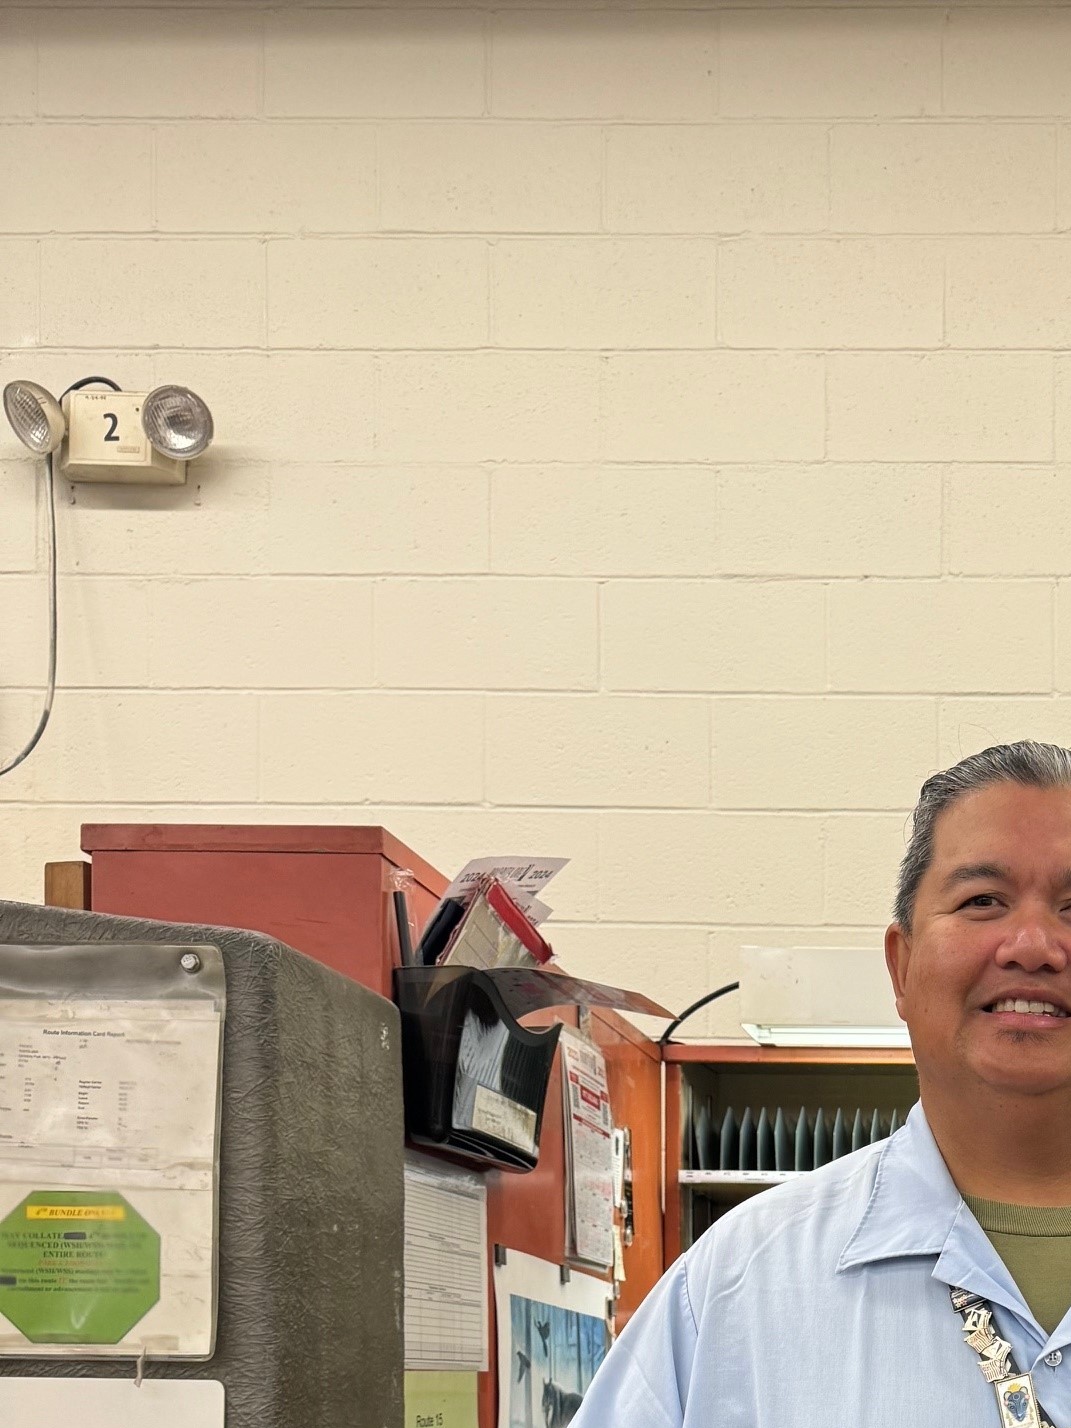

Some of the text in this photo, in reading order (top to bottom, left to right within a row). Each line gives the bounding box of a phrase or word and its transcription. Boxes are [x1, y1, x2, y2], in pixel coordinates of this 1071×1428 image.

[103, 413, 119, 441] 2
[528, 870, 554, 880] 2024
[49, 1209, 82, 1217] BUNDLE
[416, 1413, 443, 1428] Route 15
